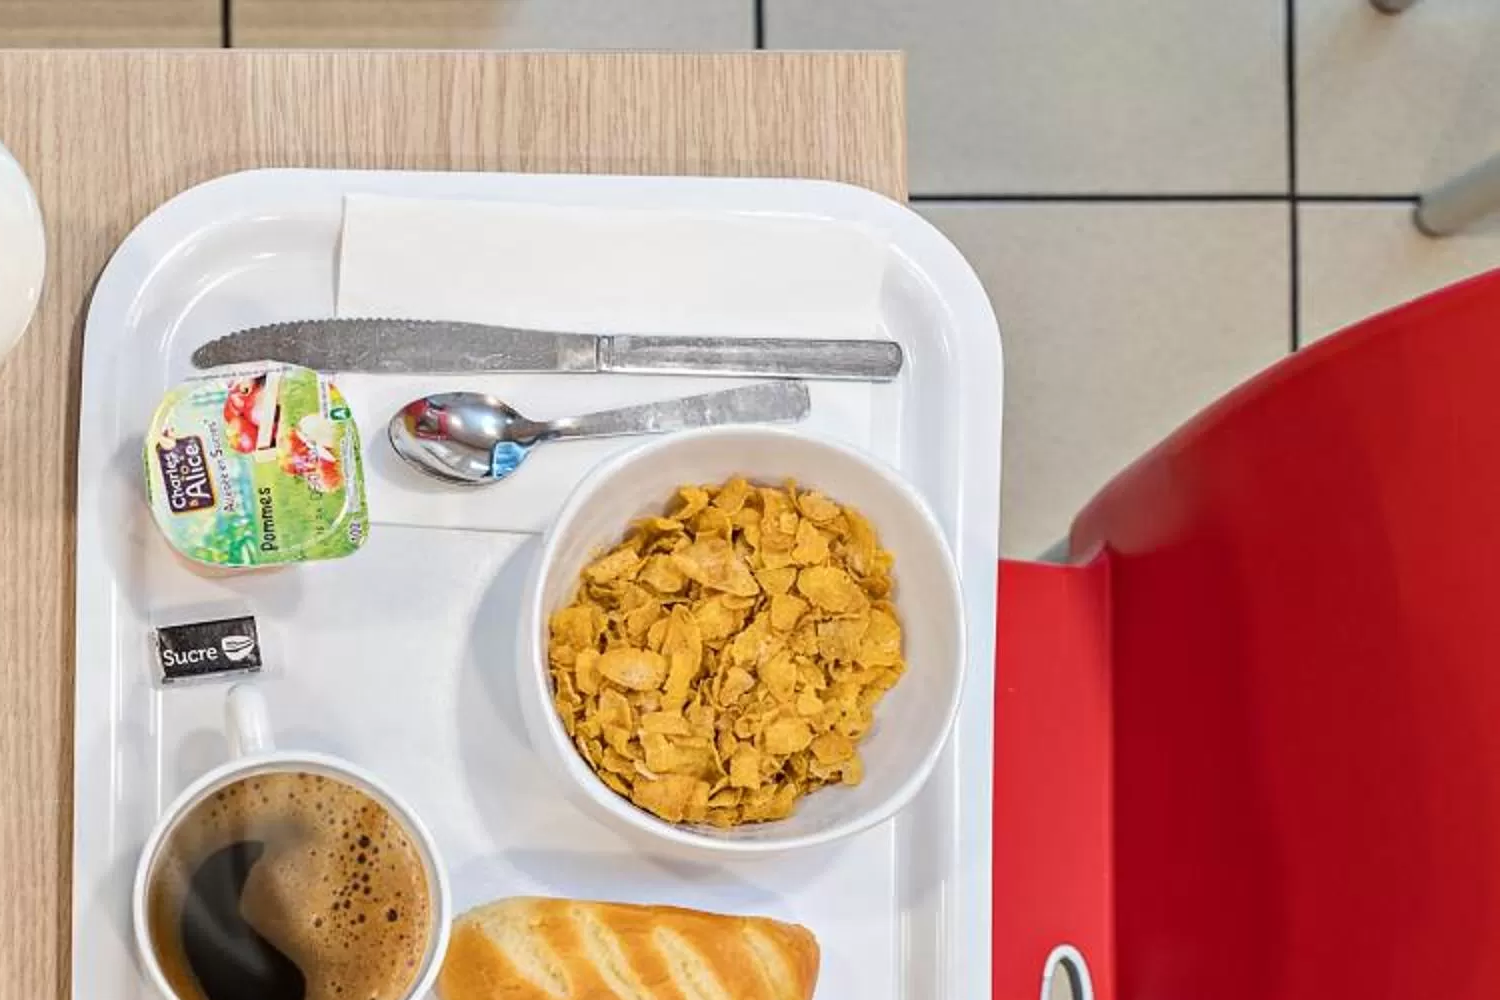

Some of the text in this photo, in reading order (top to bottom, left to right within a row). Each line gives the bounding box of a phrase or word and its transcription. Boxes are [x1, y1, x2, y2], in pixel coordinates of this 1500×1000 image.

[163, 451, 187, 510] Charles
[185, 441, 211, 499] Alice
[163, 646, 218, 666] Sucre
